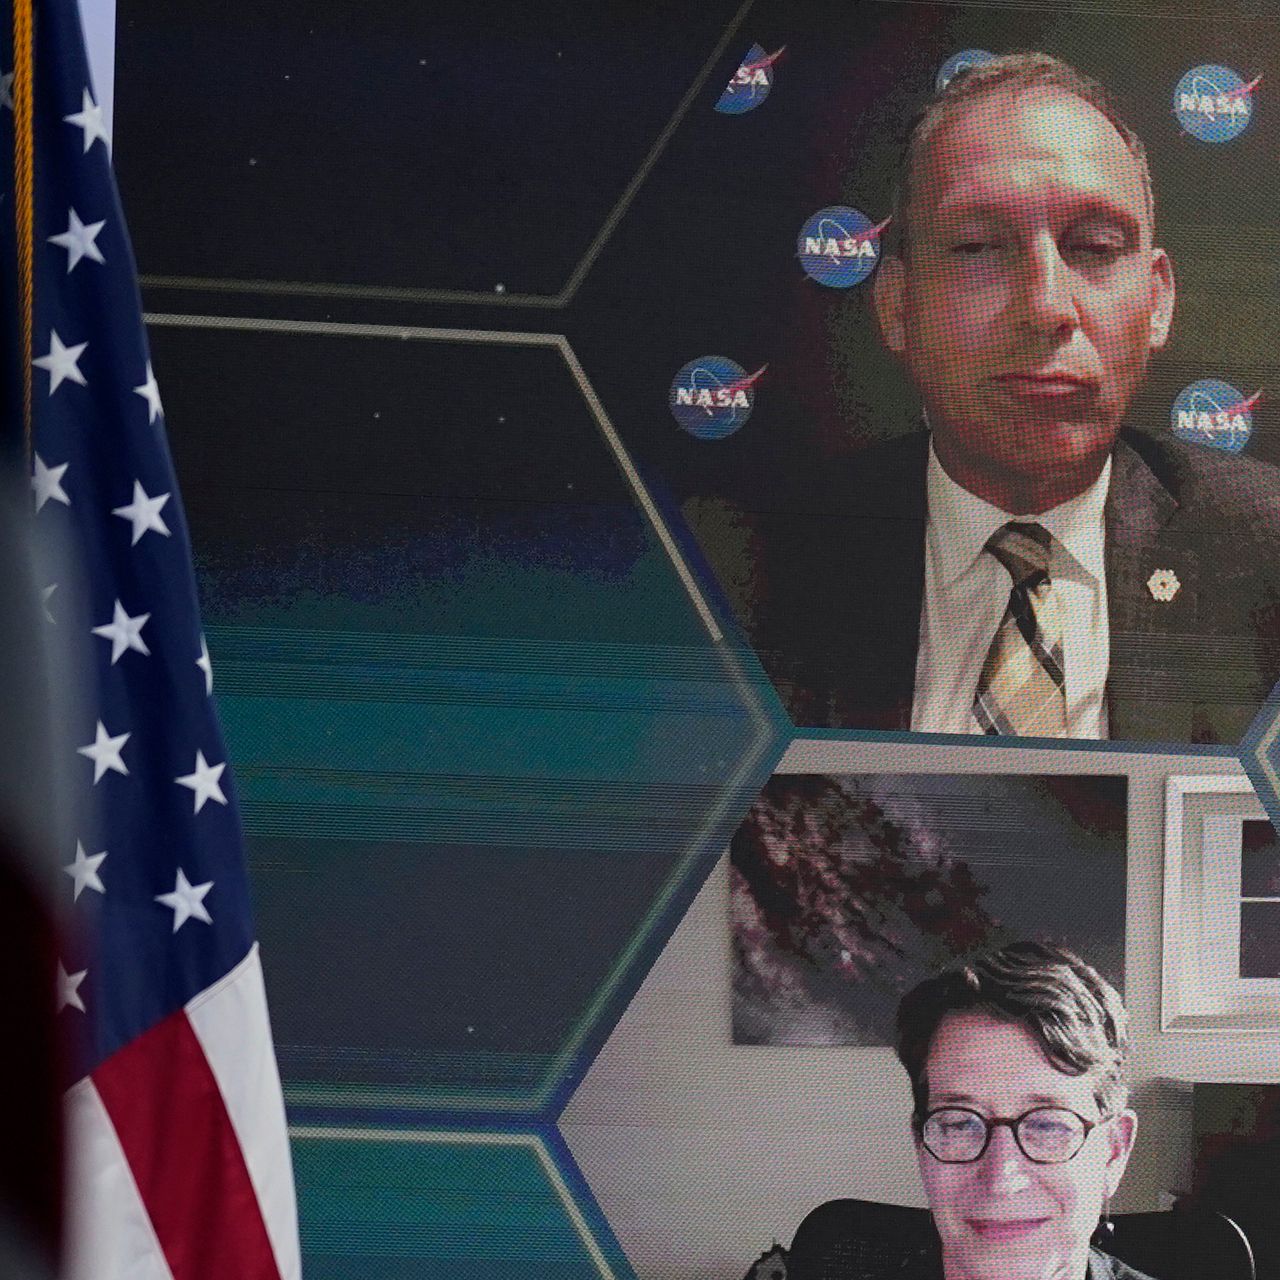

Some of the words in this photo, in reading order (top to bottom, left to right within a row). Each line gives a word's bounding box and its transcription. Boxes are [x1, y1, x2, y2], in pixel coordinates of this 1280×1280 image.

[1180, 93, 1247, 114] NASA
[803, 236, 877, 256] NASA
[675, 387, 750, 408] NASA
[1178, 410, 1248, 431] NASA
